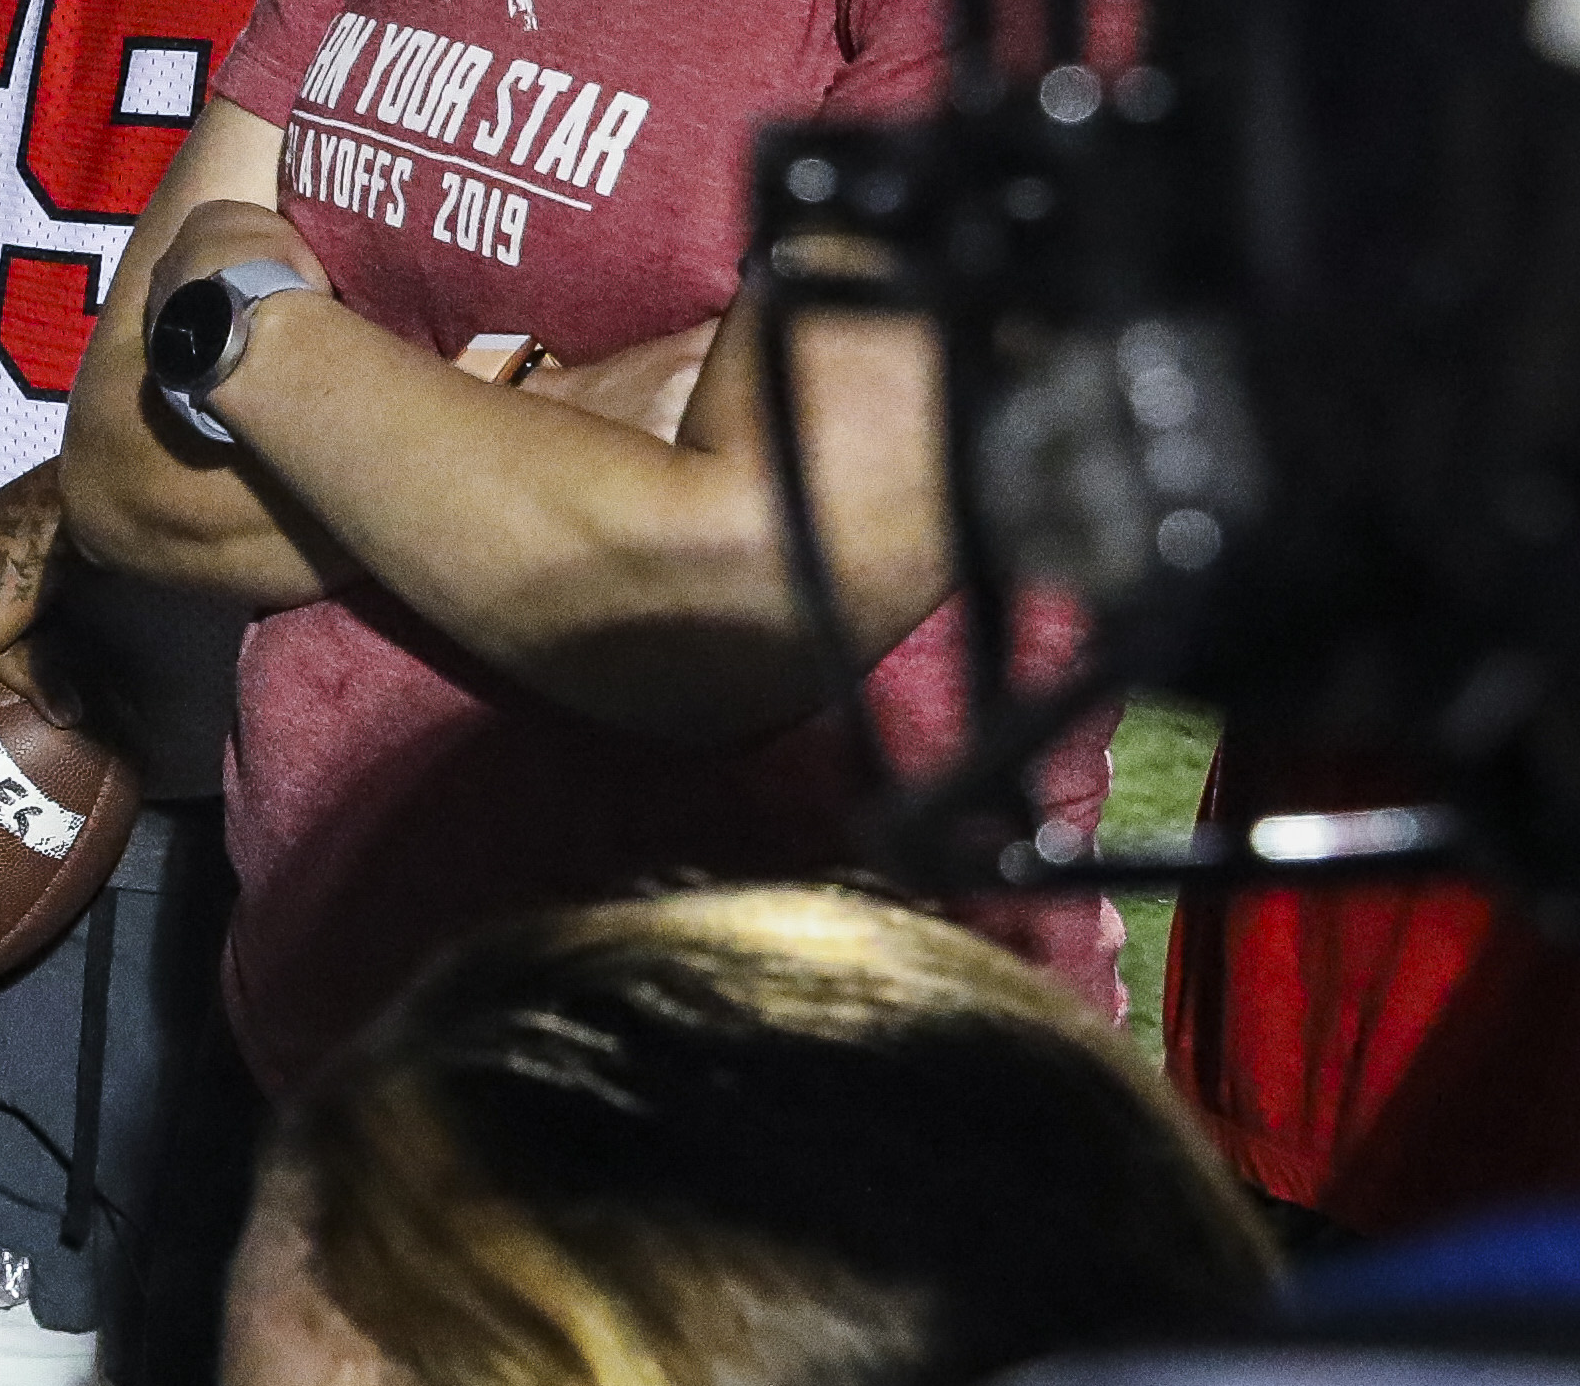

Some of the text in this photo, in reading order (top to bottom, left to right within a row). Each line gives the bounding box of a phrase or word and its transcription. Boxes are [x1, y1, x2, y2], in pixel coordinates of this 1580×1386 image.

[353, 22, 495, 144] YOUR
[471, 58, 651, 198] STAR
[431, 172, 531, 268] 2019
